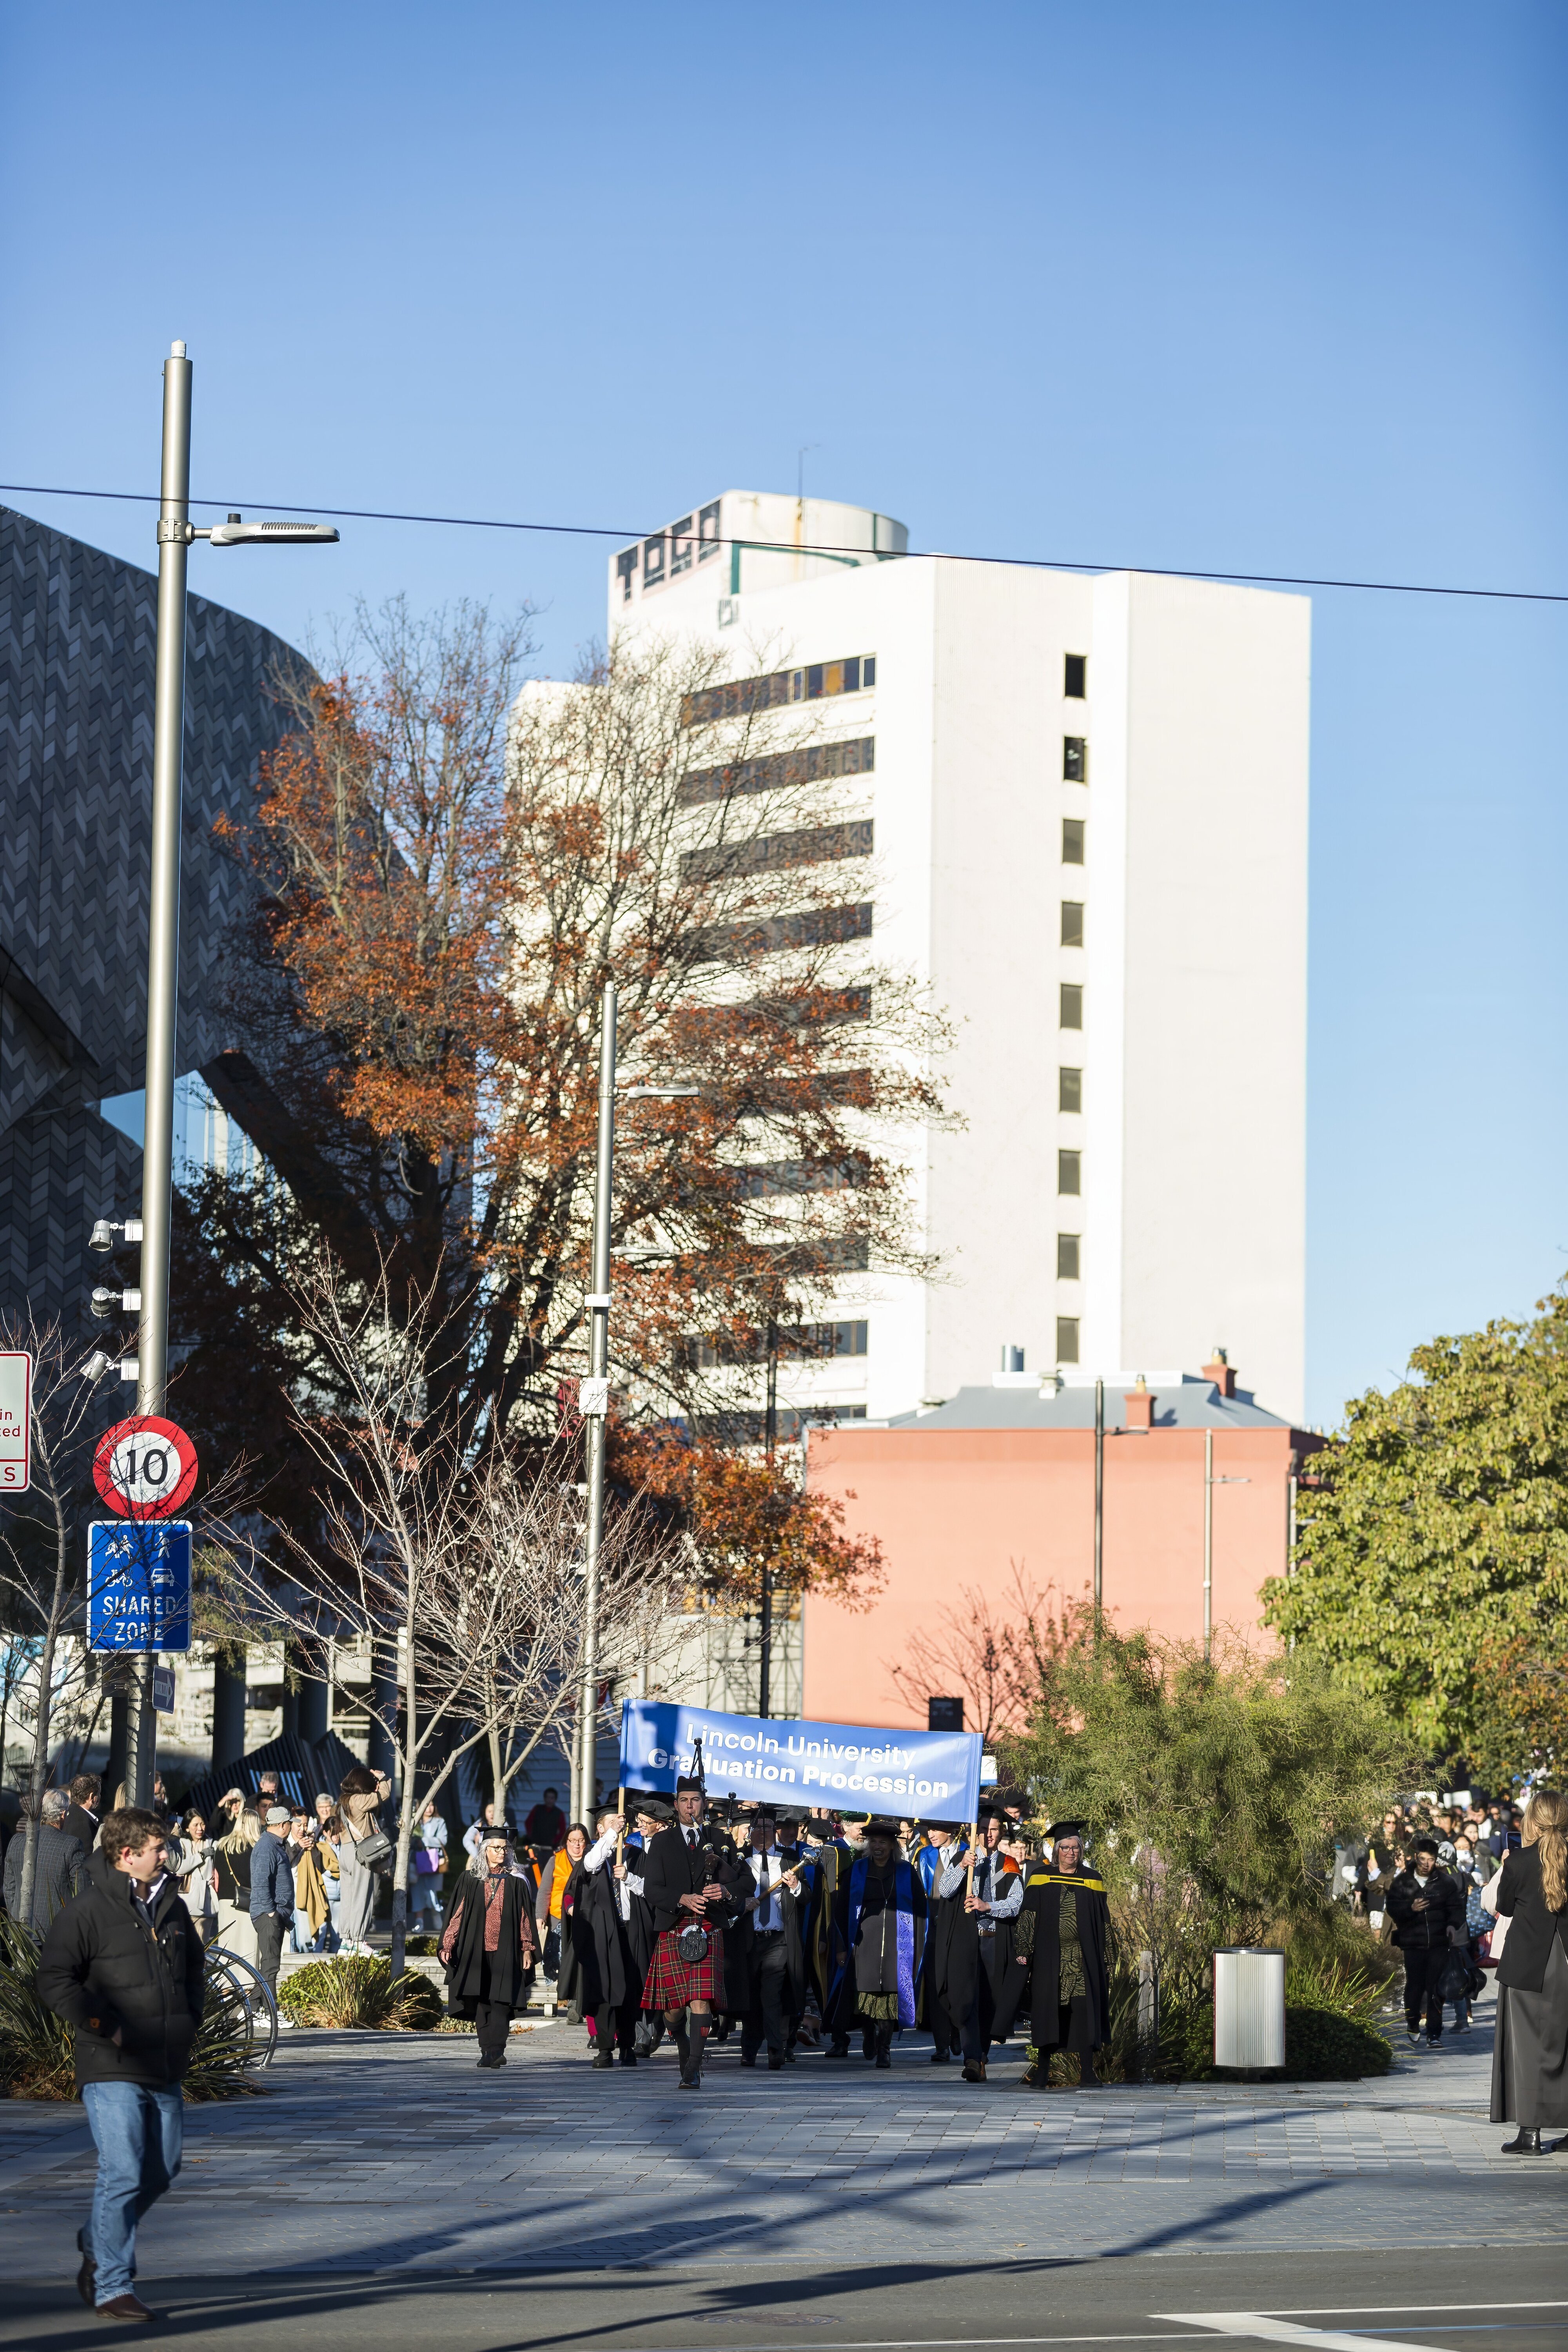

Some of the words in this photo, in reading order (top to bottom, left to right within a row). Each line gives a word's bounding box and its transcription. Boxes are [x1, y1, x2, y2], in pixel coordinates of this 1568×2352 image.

[0, 1425, 20, 1437] ed
[127, 1449, 168, 1485] 10
[103, 1596, 176, 1615] SHARED
[114, 1622, 164, 1641] ZONE
[686, 1723, 779, 1754] Lincoln
[788, 1735, 916, 1770] University
[648, 1748, 796, 1783] Graduation
[802, 1765, 949, 1798] Procession
